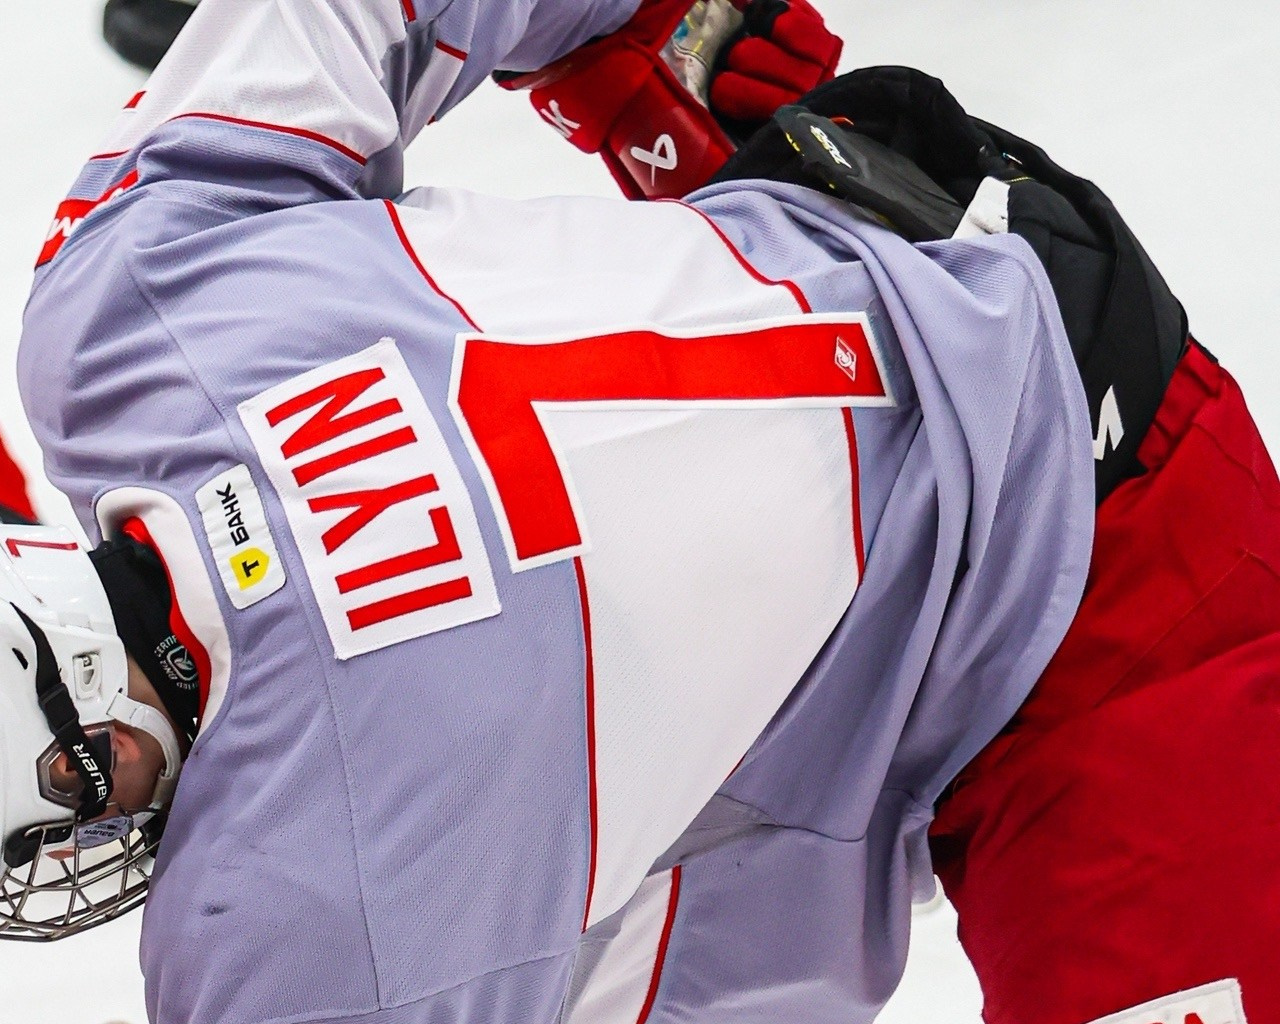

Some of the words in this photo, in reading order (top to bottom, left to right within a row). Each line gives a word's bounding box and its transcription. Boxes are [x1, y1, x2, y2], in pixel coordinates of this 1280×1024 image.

[216, 482, 250, 546] БАНК
[265, 366, 473, 632] ILYIN
[456, 321, 888, 566] 7
